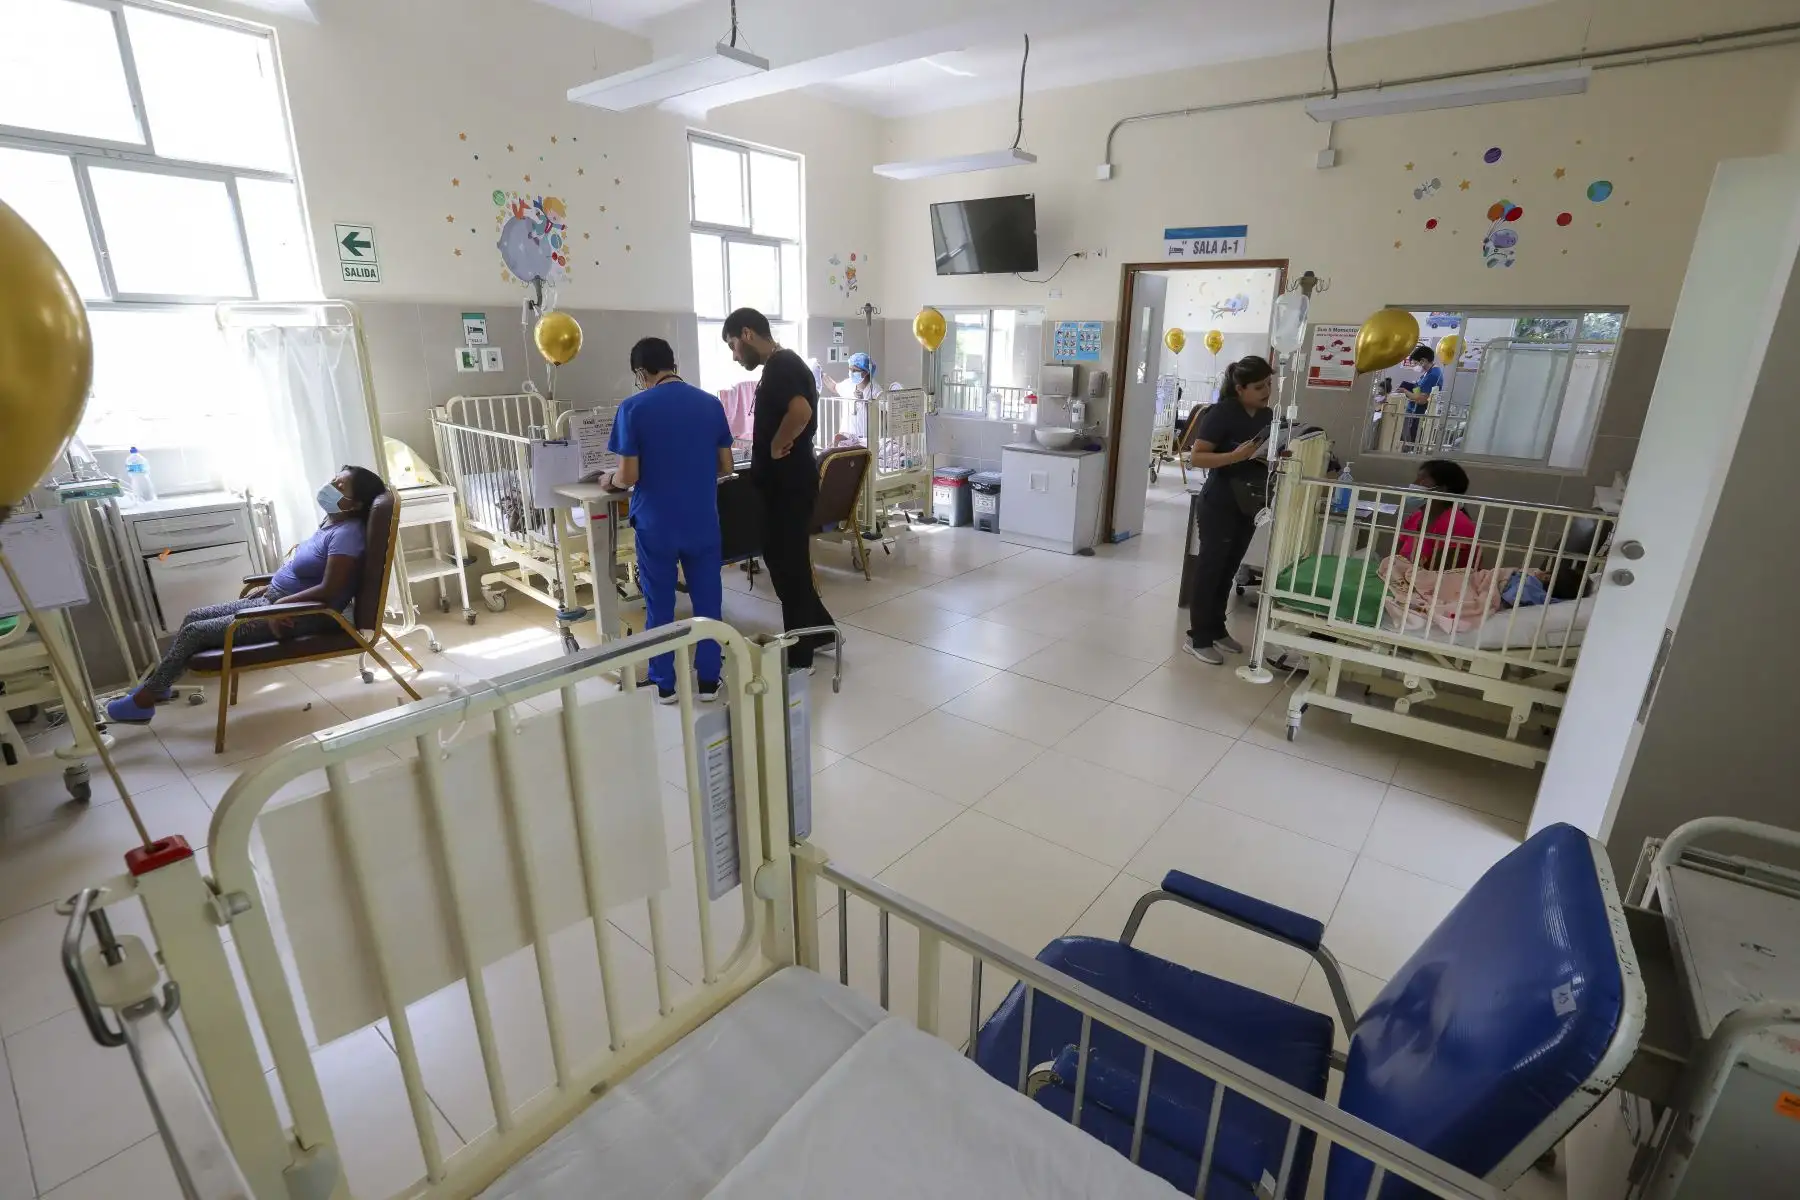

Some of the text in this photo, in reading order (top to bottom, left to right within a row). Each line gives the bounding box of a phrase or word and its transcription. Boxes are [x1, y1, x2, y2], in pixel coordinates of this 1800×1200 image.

[1193, 239, 1239, 255] SALA A-1
[344, 267, 377, 278] SALIDA
